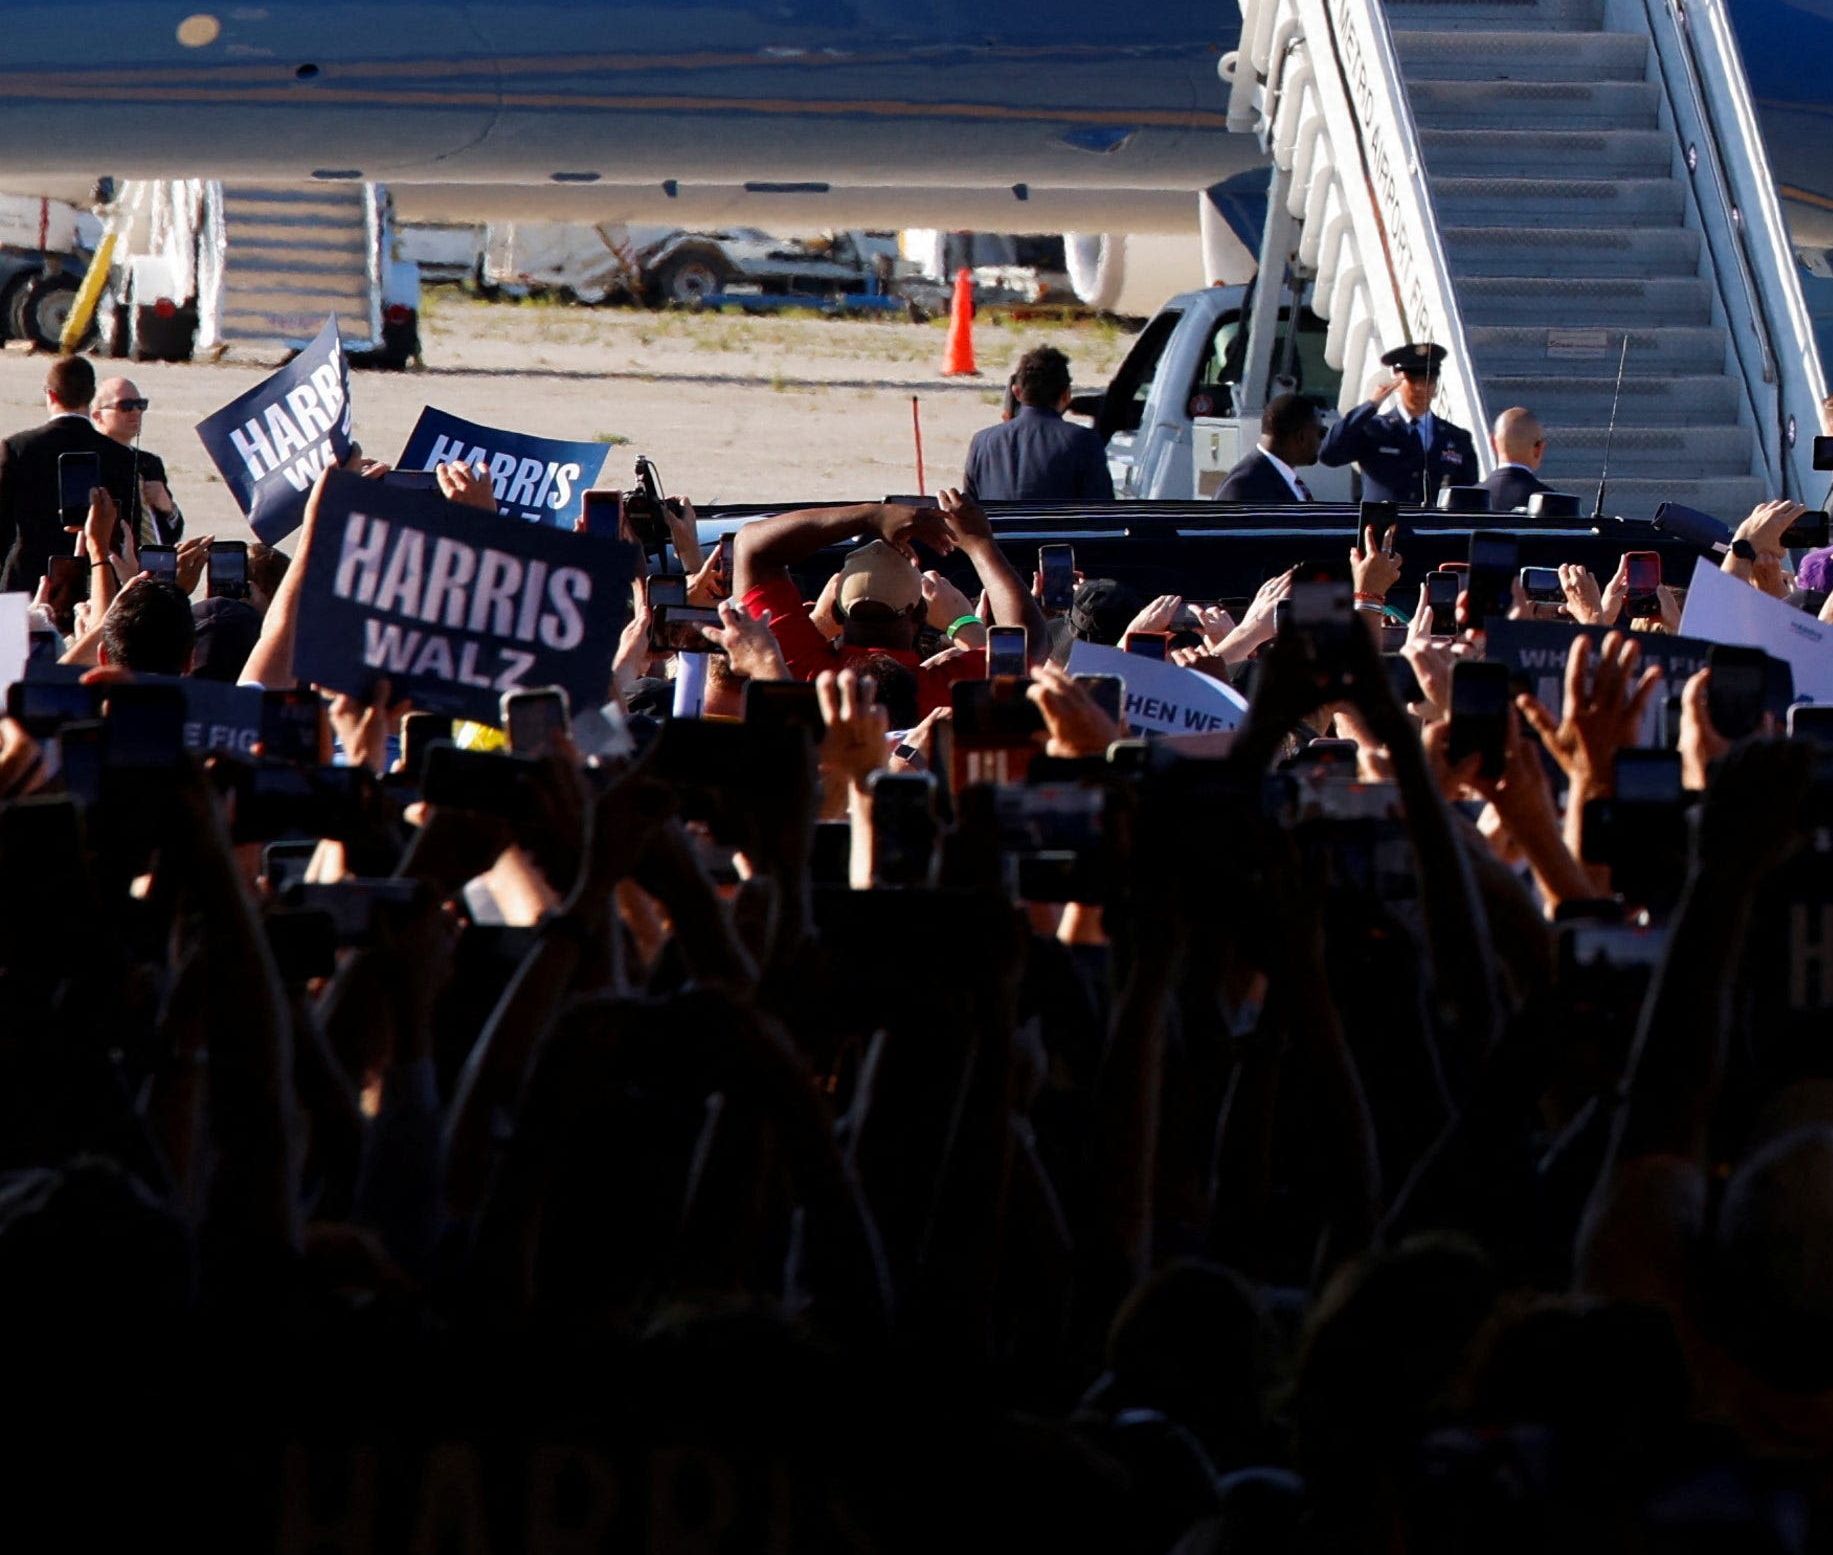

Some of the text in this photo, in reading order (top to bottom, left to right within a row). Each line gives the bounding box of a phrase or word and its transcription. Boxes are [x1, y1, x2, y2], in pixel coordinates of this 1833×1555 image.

[1371, 121, 1414, 284] AIRPORT
[332, 511, 593, 651] HARRIS
[363, 618, 538, 691] WALZ
[1125, 694, 1178, 724] HEN
